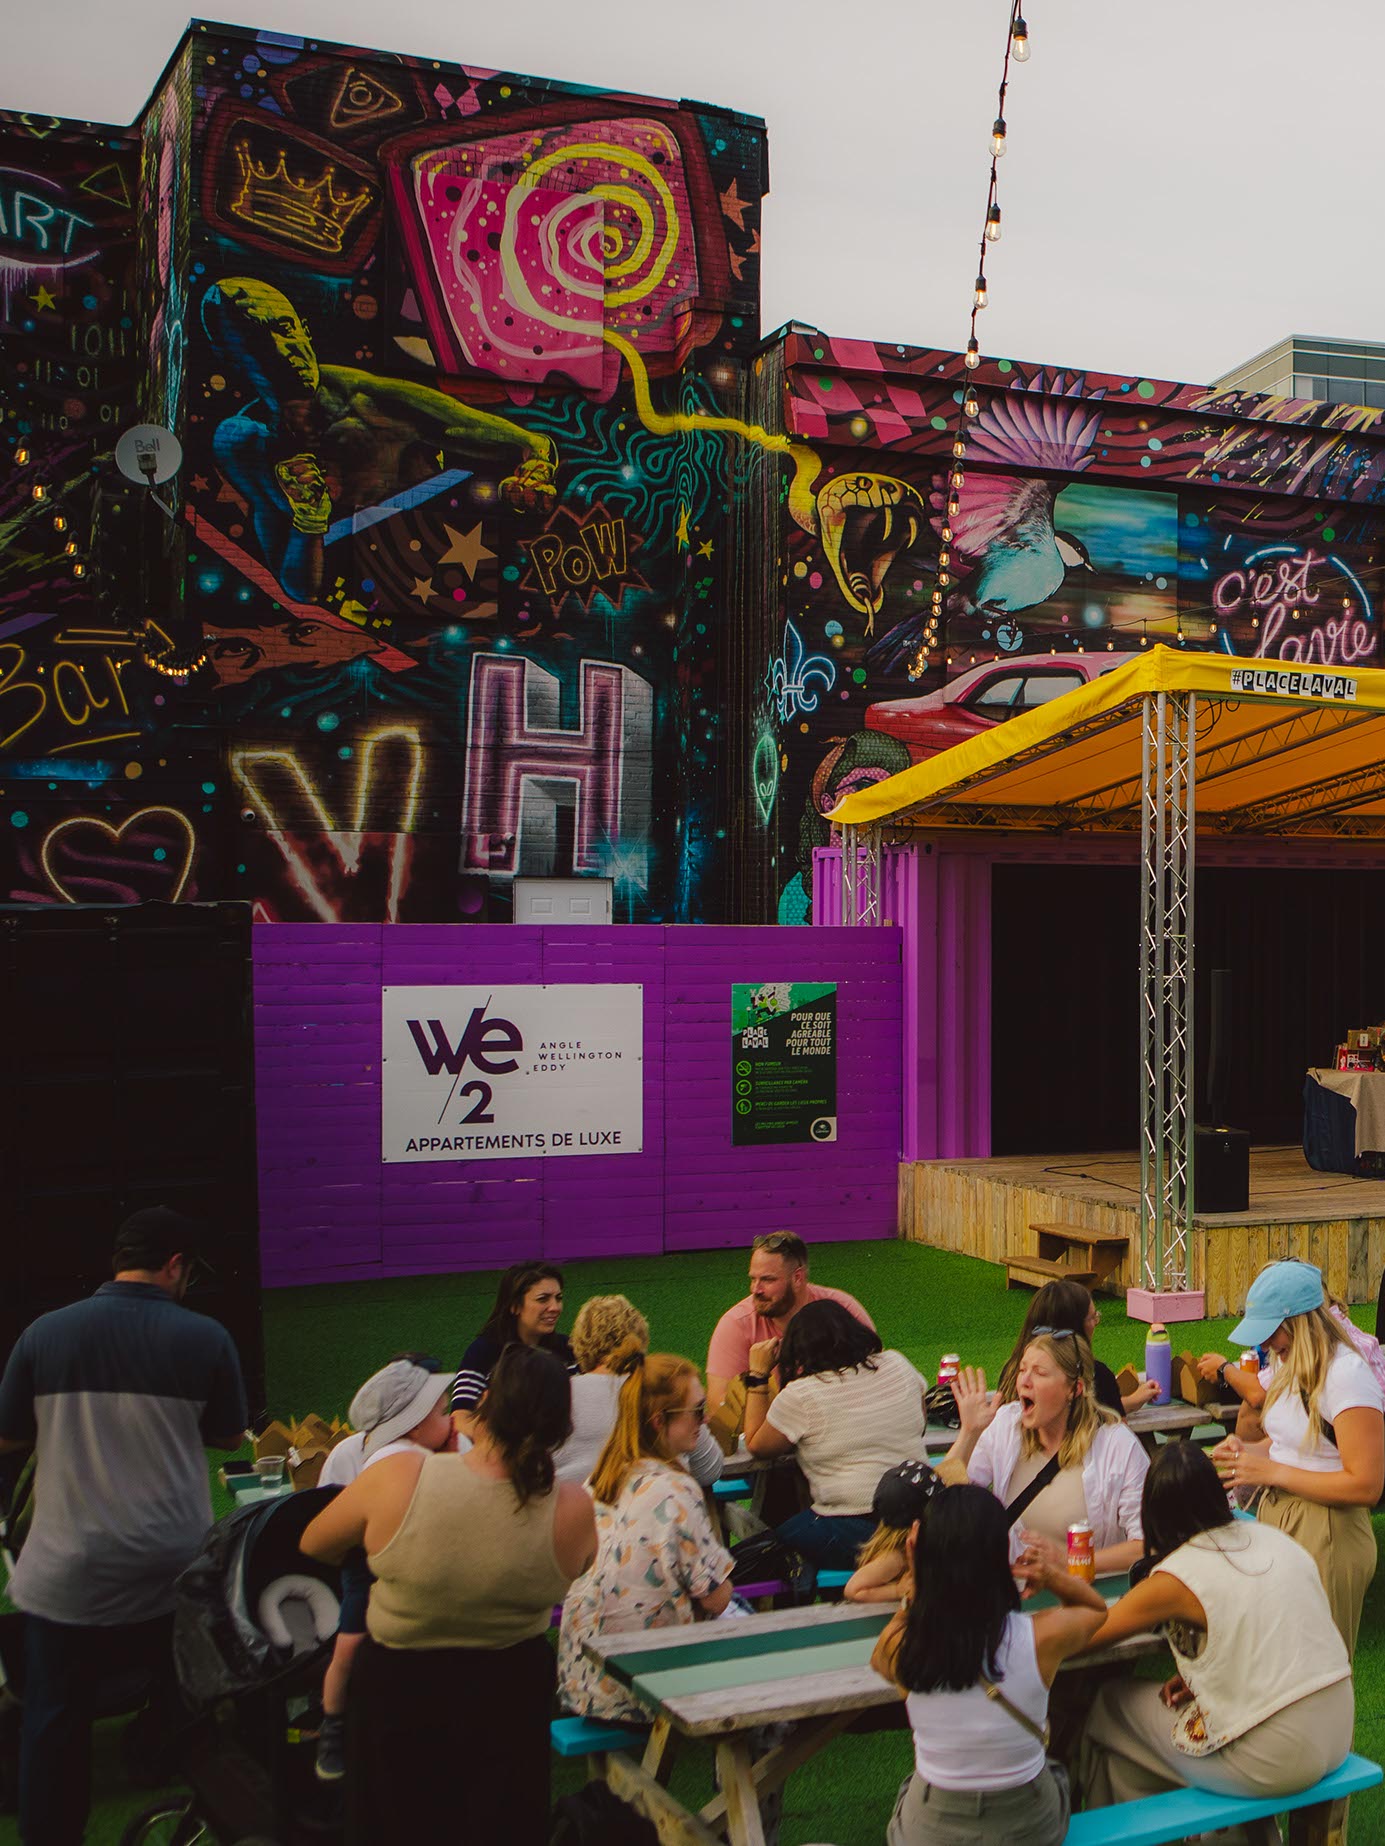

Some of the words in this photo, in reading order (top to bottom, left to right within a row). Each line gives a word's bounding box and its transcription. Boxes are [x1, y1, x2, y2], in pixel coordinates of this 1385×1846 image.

[134, 438, 160, 452] Bell
[1231, 669, 1357, 698] #PLACELAVAL
[790, 1012, 813, 1021] POUR
[814, 1012, 832, 1021] QUE
[801, 1021, 811, 1030] CE
[812, 1021, 832, 1029] SOIT
[742, 1027, 768, 1038] PLACE
[540, 1041, 582, 1049] ANGLE
[742, 1037, 769, 1048] LAVAL
[785, 1038, 809, 1047] POUR
[809, 1038, 832, 1046] TOUT
[791, 1047, 801, 1055] LE
[802, 1046, 831, 1055] MONDE
[538, 1051, 622, 1061] WELLINGTON
[533, 1064, 566, 1072] EDDY
[405, 1134, 546, 1153] APPARTEMENTS
[551, 1132, 573, 1147] DE
[579, 1131, 622, 1145] LUXE
